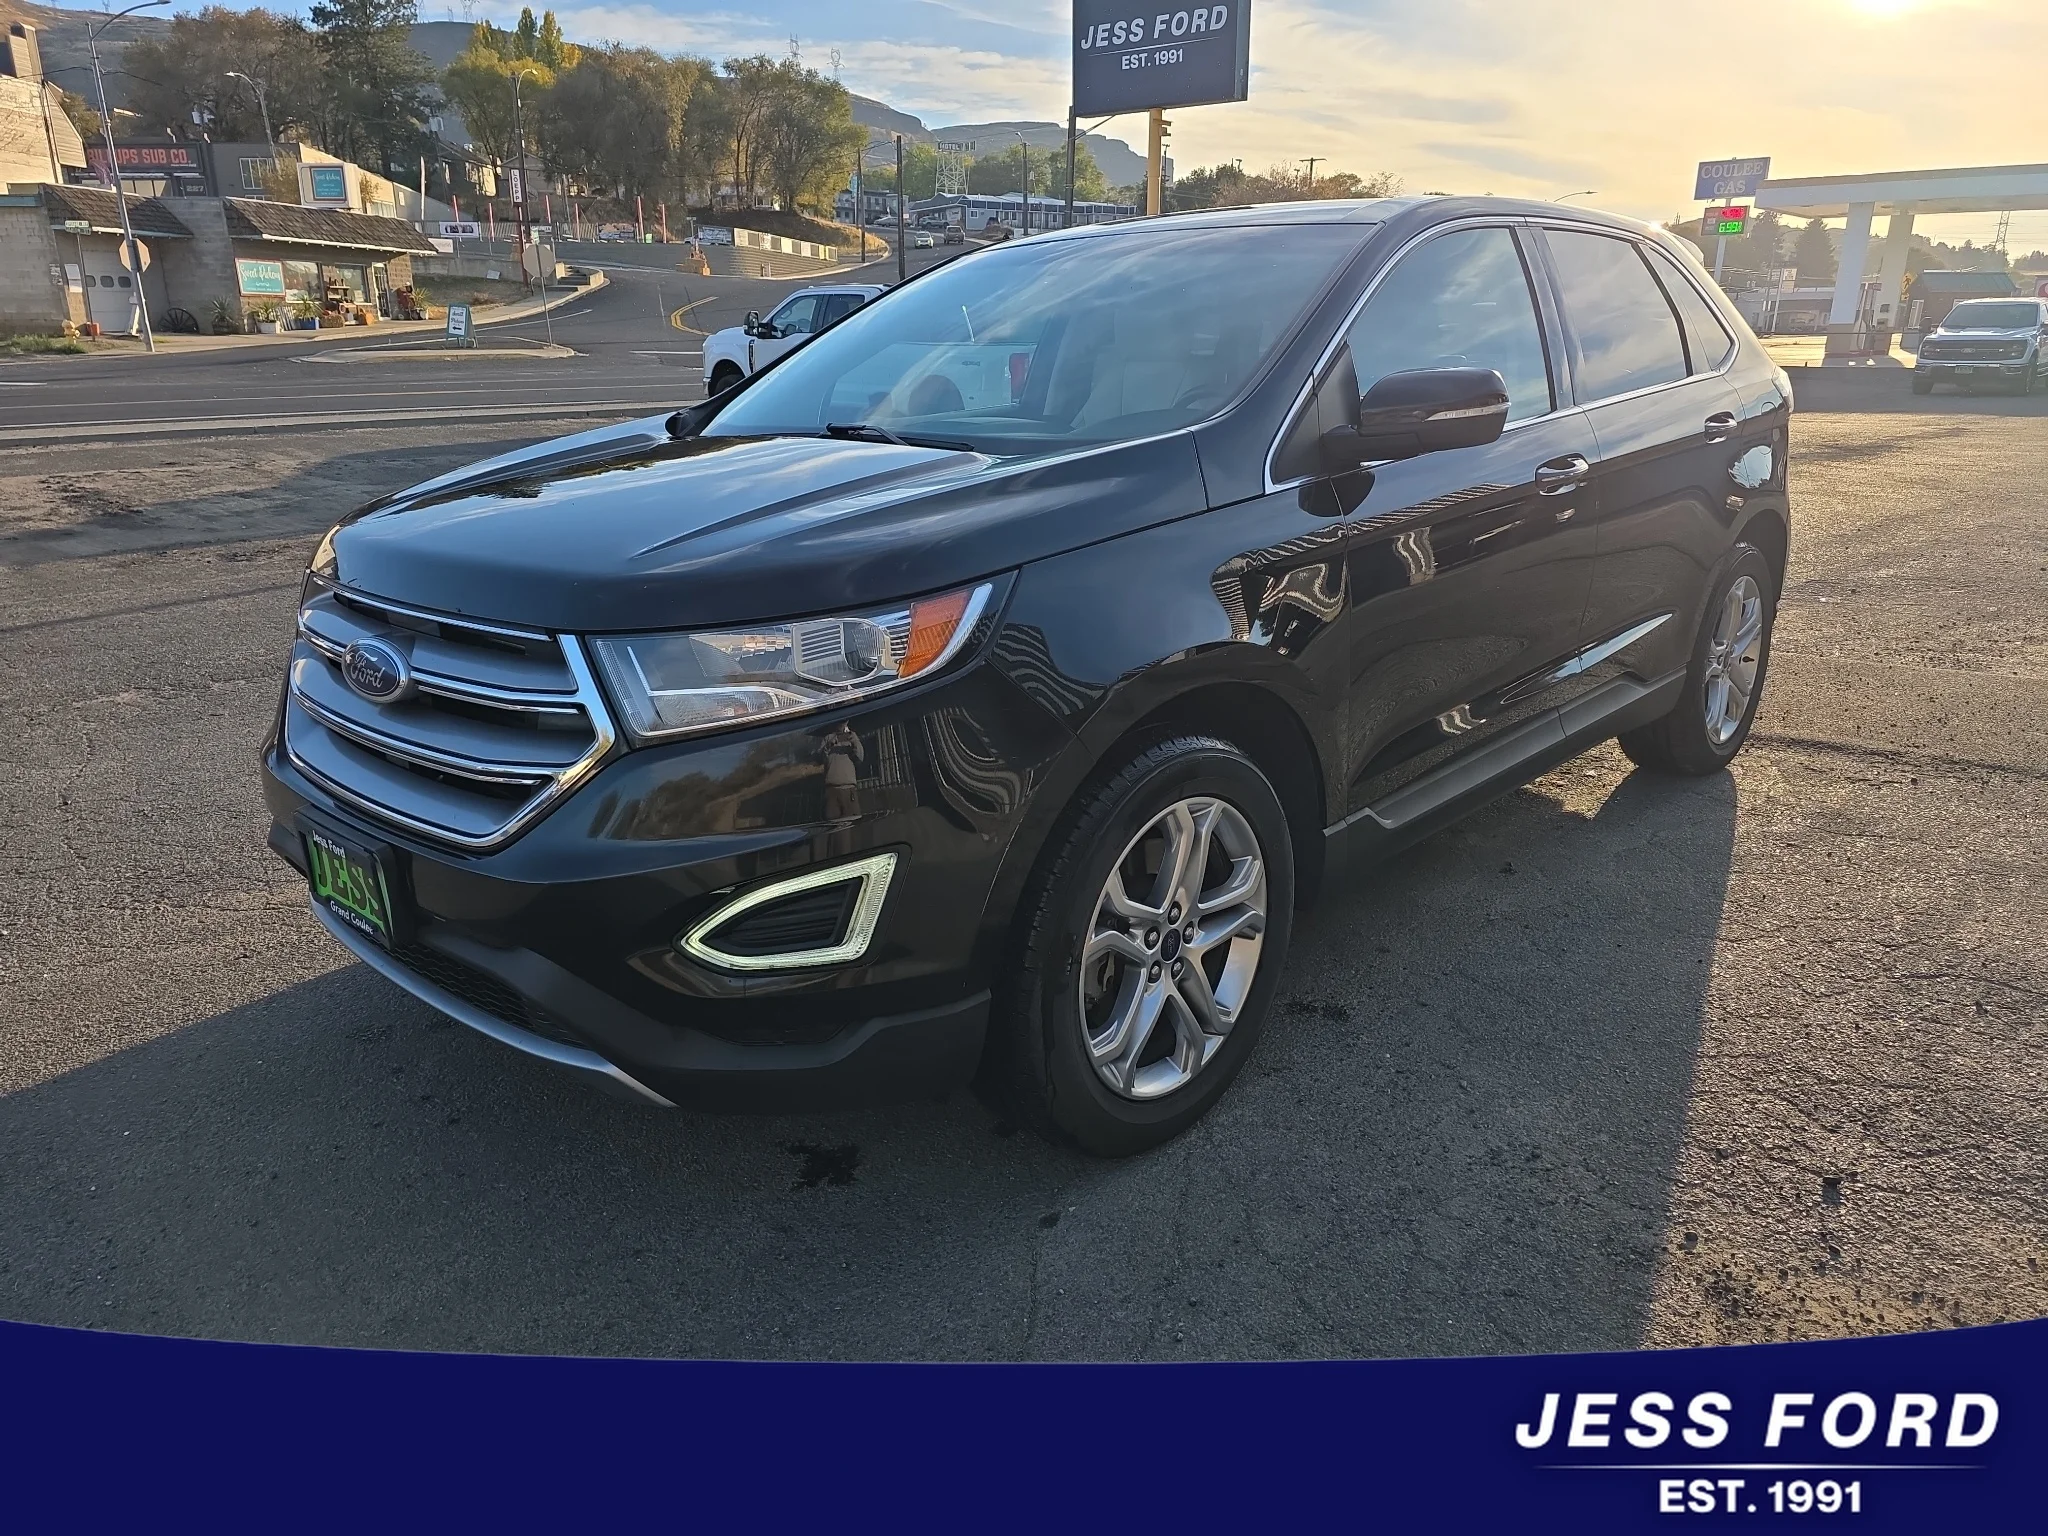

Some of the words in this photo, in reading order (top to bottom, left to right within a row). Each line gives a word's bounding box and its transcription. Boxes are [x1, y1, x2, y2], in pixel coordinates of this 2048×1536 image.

[1080, 18, 1145, 50] JESS
[1153, 5, 1228, 39] FORD
[1121, 53, 1151, 70] EST.
[1154, 49, 1183, 66] 1991
[142, 148, 166, 164] SUB
[171, 148, 191, 164] CO.
[1701, 162, 1764, 178] COULEE
[1713, 180, 1746, 195] GAS
[350, 650, 386, 688] Ford
[312, 829, 329, 849] Jess
[327, 840, 346, 859] Ford
[329, 899, 350, 920] Grand
